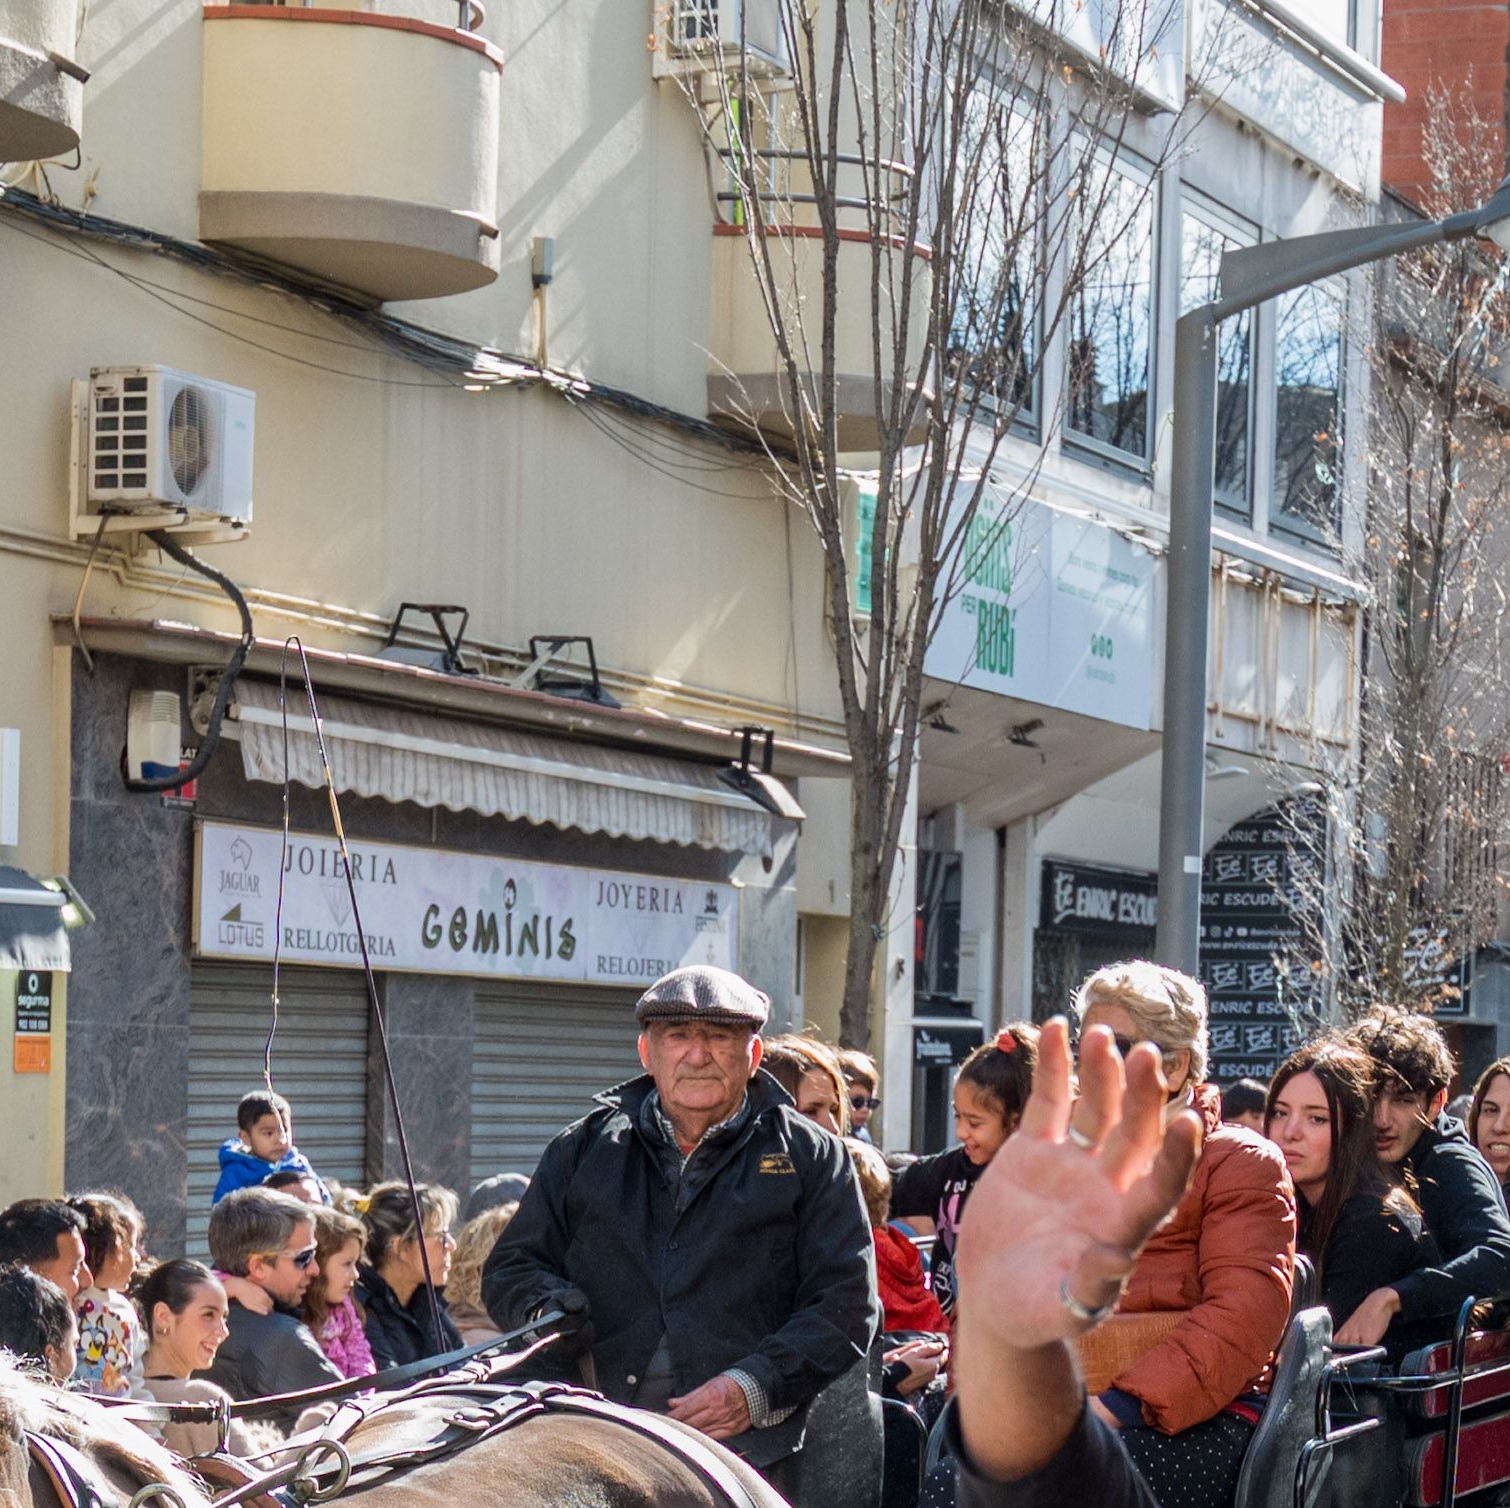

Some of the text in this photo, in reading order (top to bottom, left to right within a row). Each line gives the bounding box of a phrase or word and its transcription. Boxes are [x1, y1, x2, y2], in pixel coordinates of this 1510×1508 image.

[284, 844, 398, 885] JOIERIA
[219, 869, 262, 899] JAGUAR
[596, 880, 684, 915] JOYERIA
[1076, 886, 1117, 922] ENRIC
[218, 922, 265, 949] LOTUS
[284, 926, 397, 957] RELLOTGRIA
